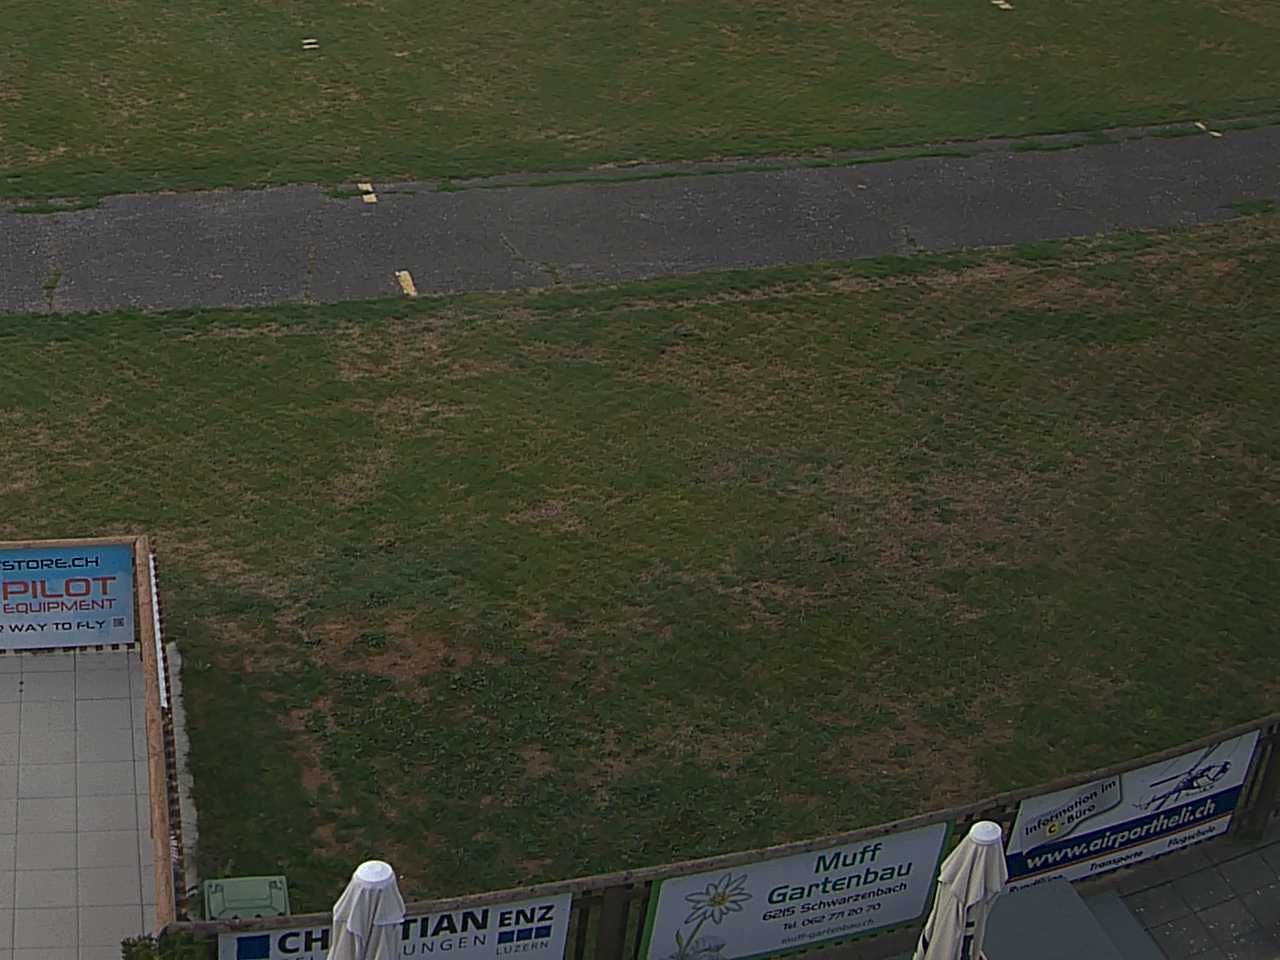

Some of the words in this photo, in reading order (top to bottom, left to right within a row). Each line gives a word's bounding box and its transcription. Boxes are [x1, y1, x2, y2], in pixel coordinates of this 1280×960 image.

[2, 576, 117, 601] PILOT
[3, 598, 117, 614] EQUIPMENT
[8, 622, 48, 634] WAY
[53, 621, 73, 631] TO
[77, 619, 106, 630] FLY
[1024, 790, 1098, 836] Information
[1101, 781, 1117, 793] im
[1026, 798, 1216, 869] www.airportheli.ch
[814, 842, 883, 874] Muff
[767, 861, 913, 905] Gartenbau
[762, 905, 797, 922] 6215
[800, 881, 908, 915] Schwarzenbach
[499, 904, 555, 928] ENZ
[801, 913, 826, 927] 062
[496, 940, 549, 956] LUZERN
